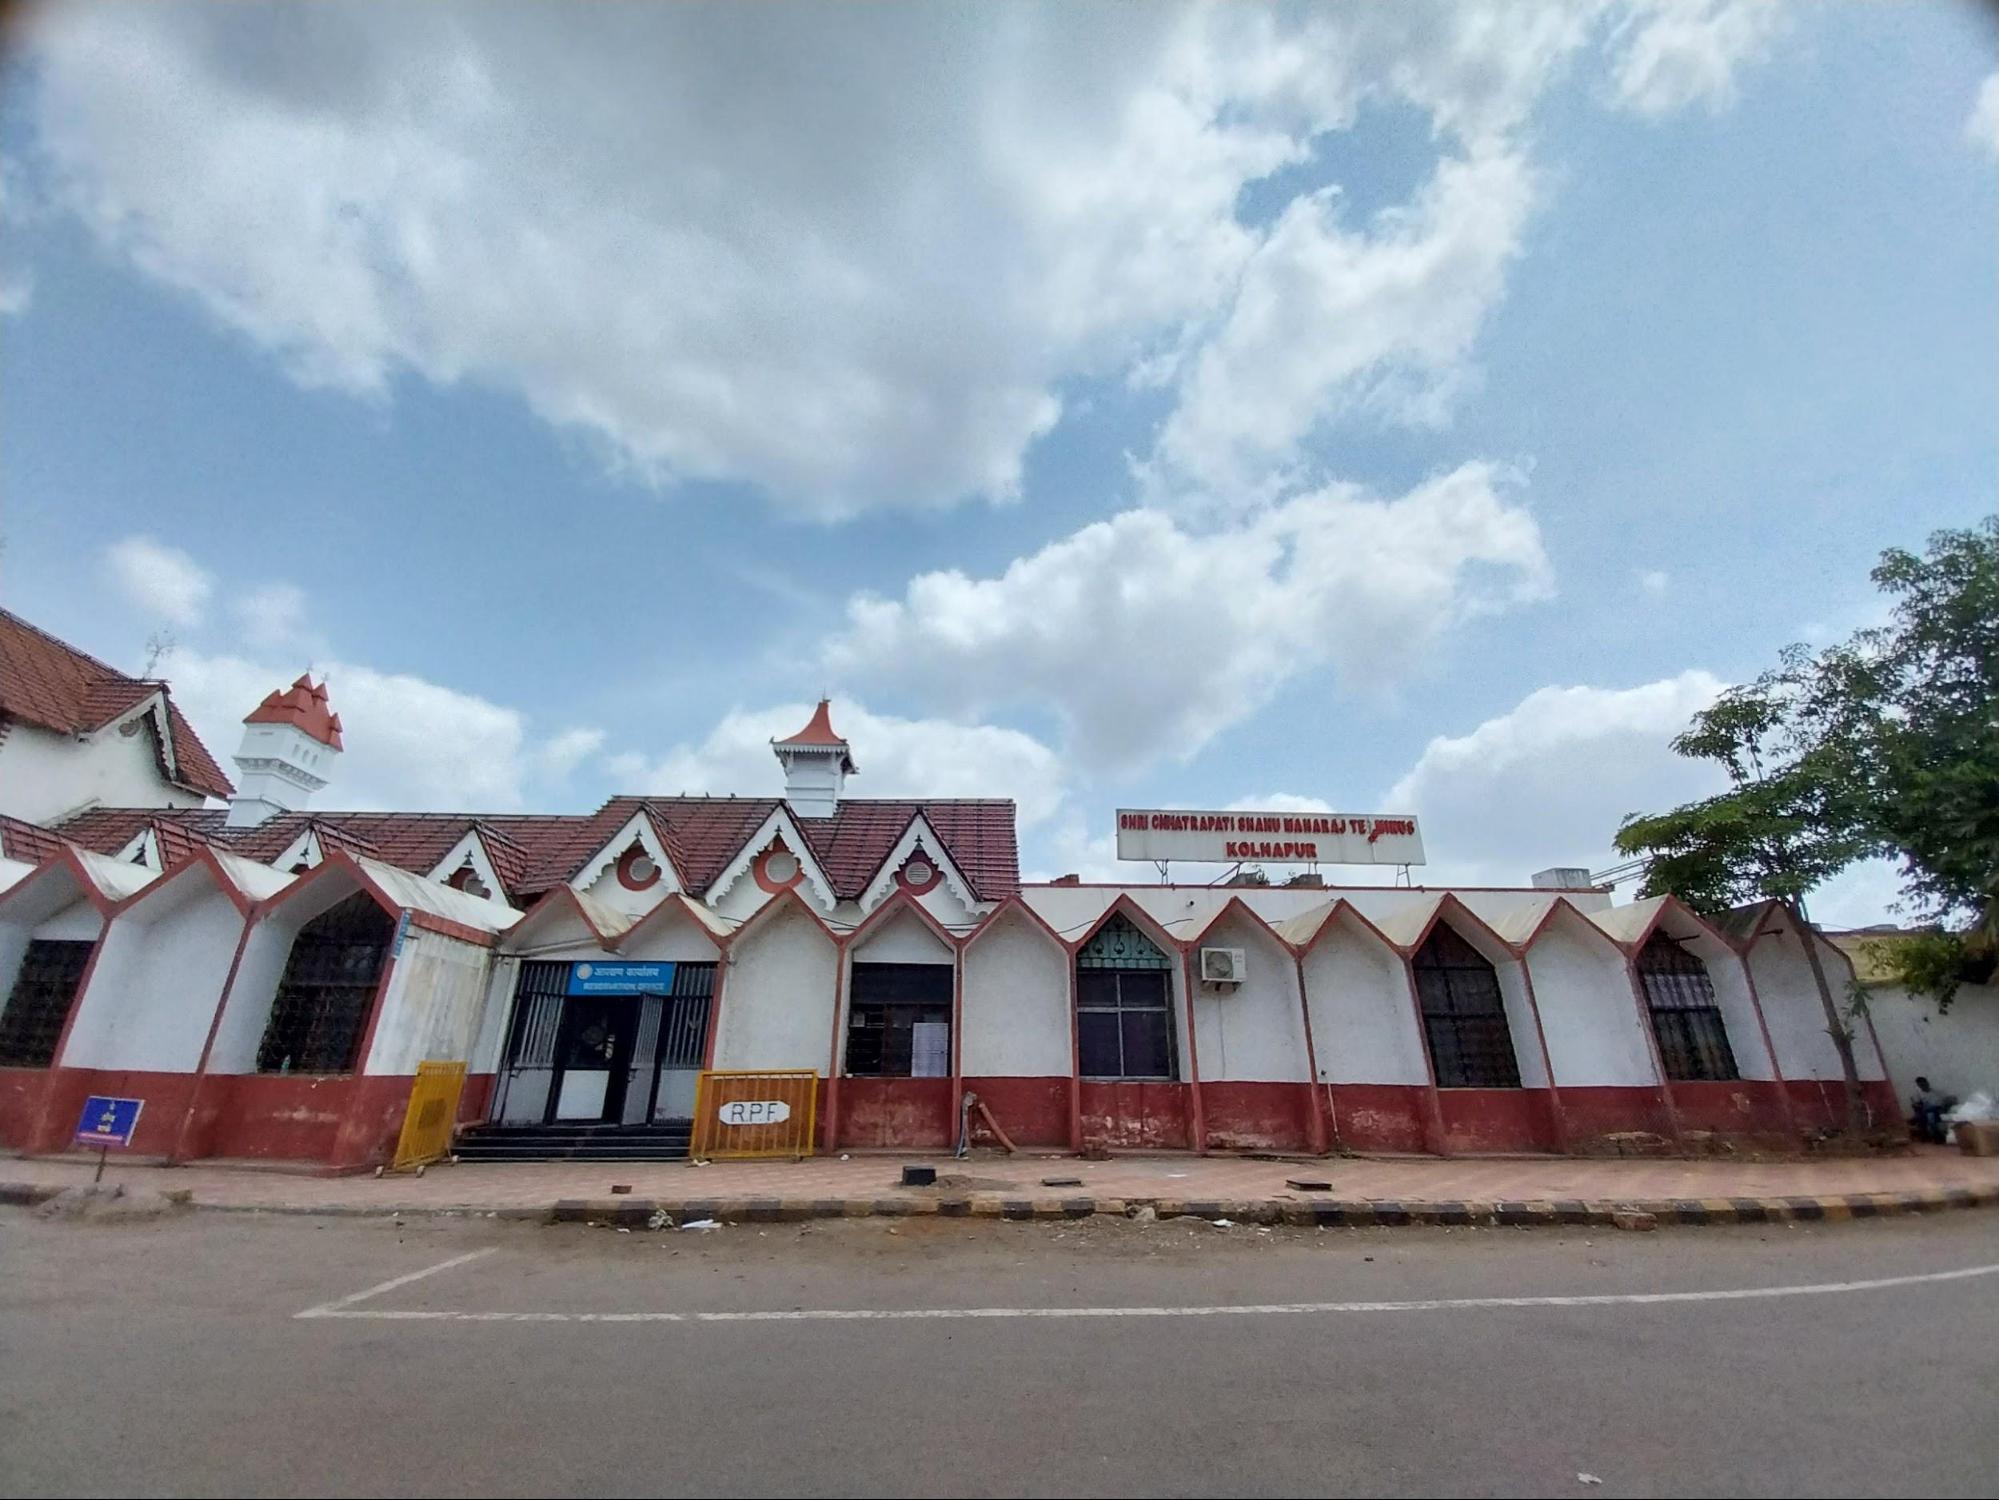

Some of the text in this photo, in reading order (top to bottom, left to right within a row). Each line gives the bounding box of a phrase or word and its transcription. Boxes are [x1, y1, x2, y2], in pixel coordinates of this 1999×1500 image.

[1121, 814, 1148, 830] SHRI
[1152, 814, 1235, 832] CHHATRAPATI
[1238, 817, 1280, 832] SHAHU
[1284, 817, 1346, 834] MAHARAJ
[1226, 841, 1317, 858] KOLHAPUR
